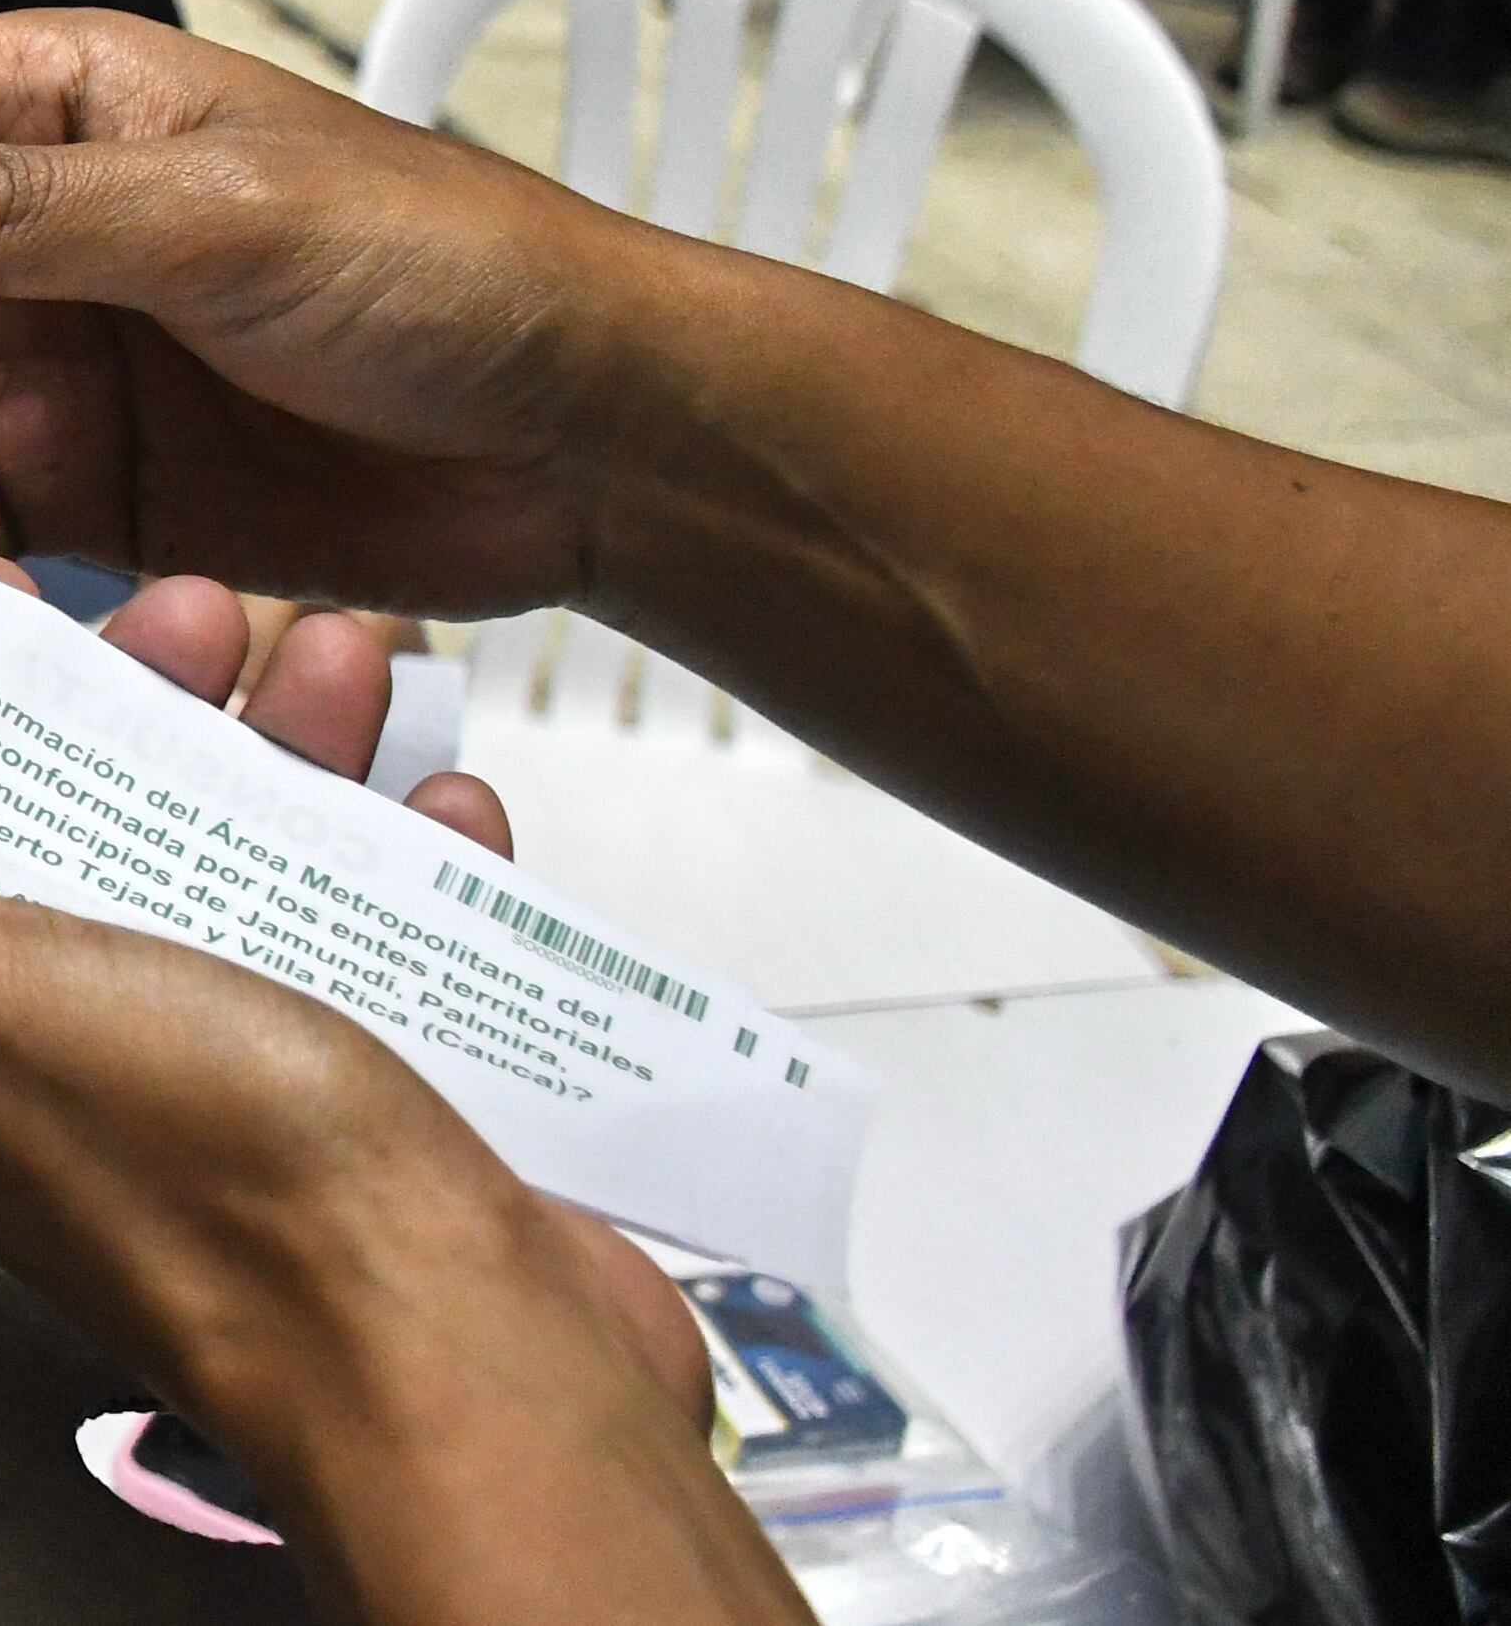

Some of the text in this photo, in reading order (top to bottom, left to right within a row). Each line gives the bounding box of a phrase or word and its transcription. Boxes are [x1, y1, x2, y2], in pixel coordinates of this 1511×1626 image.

[79, 859, 193, 929] Tejada
[202, 926, 227, 944] y
[241, 936, 315, 986] Villa
[328, 979, 409, 1027] Rica
[422, 1020, 593, 1102] (Cauca)?
[146, 790, 200, 826] del
[205, 818, 288, 874] Área
[299, 865, 544, 1002] Metropolitana
[557, 999, 613, 1033] del
[184, 885, 227, 913] de
[237, 911, 402, 1000] Jamundí,
[418, 991, 567, 1084] Palmira,
[193, 854, 259, 891] por
[266, 885, 319, 924] los
[330, 922, 428, 977] entes
[442, 972, 653, 1082] territoriales
